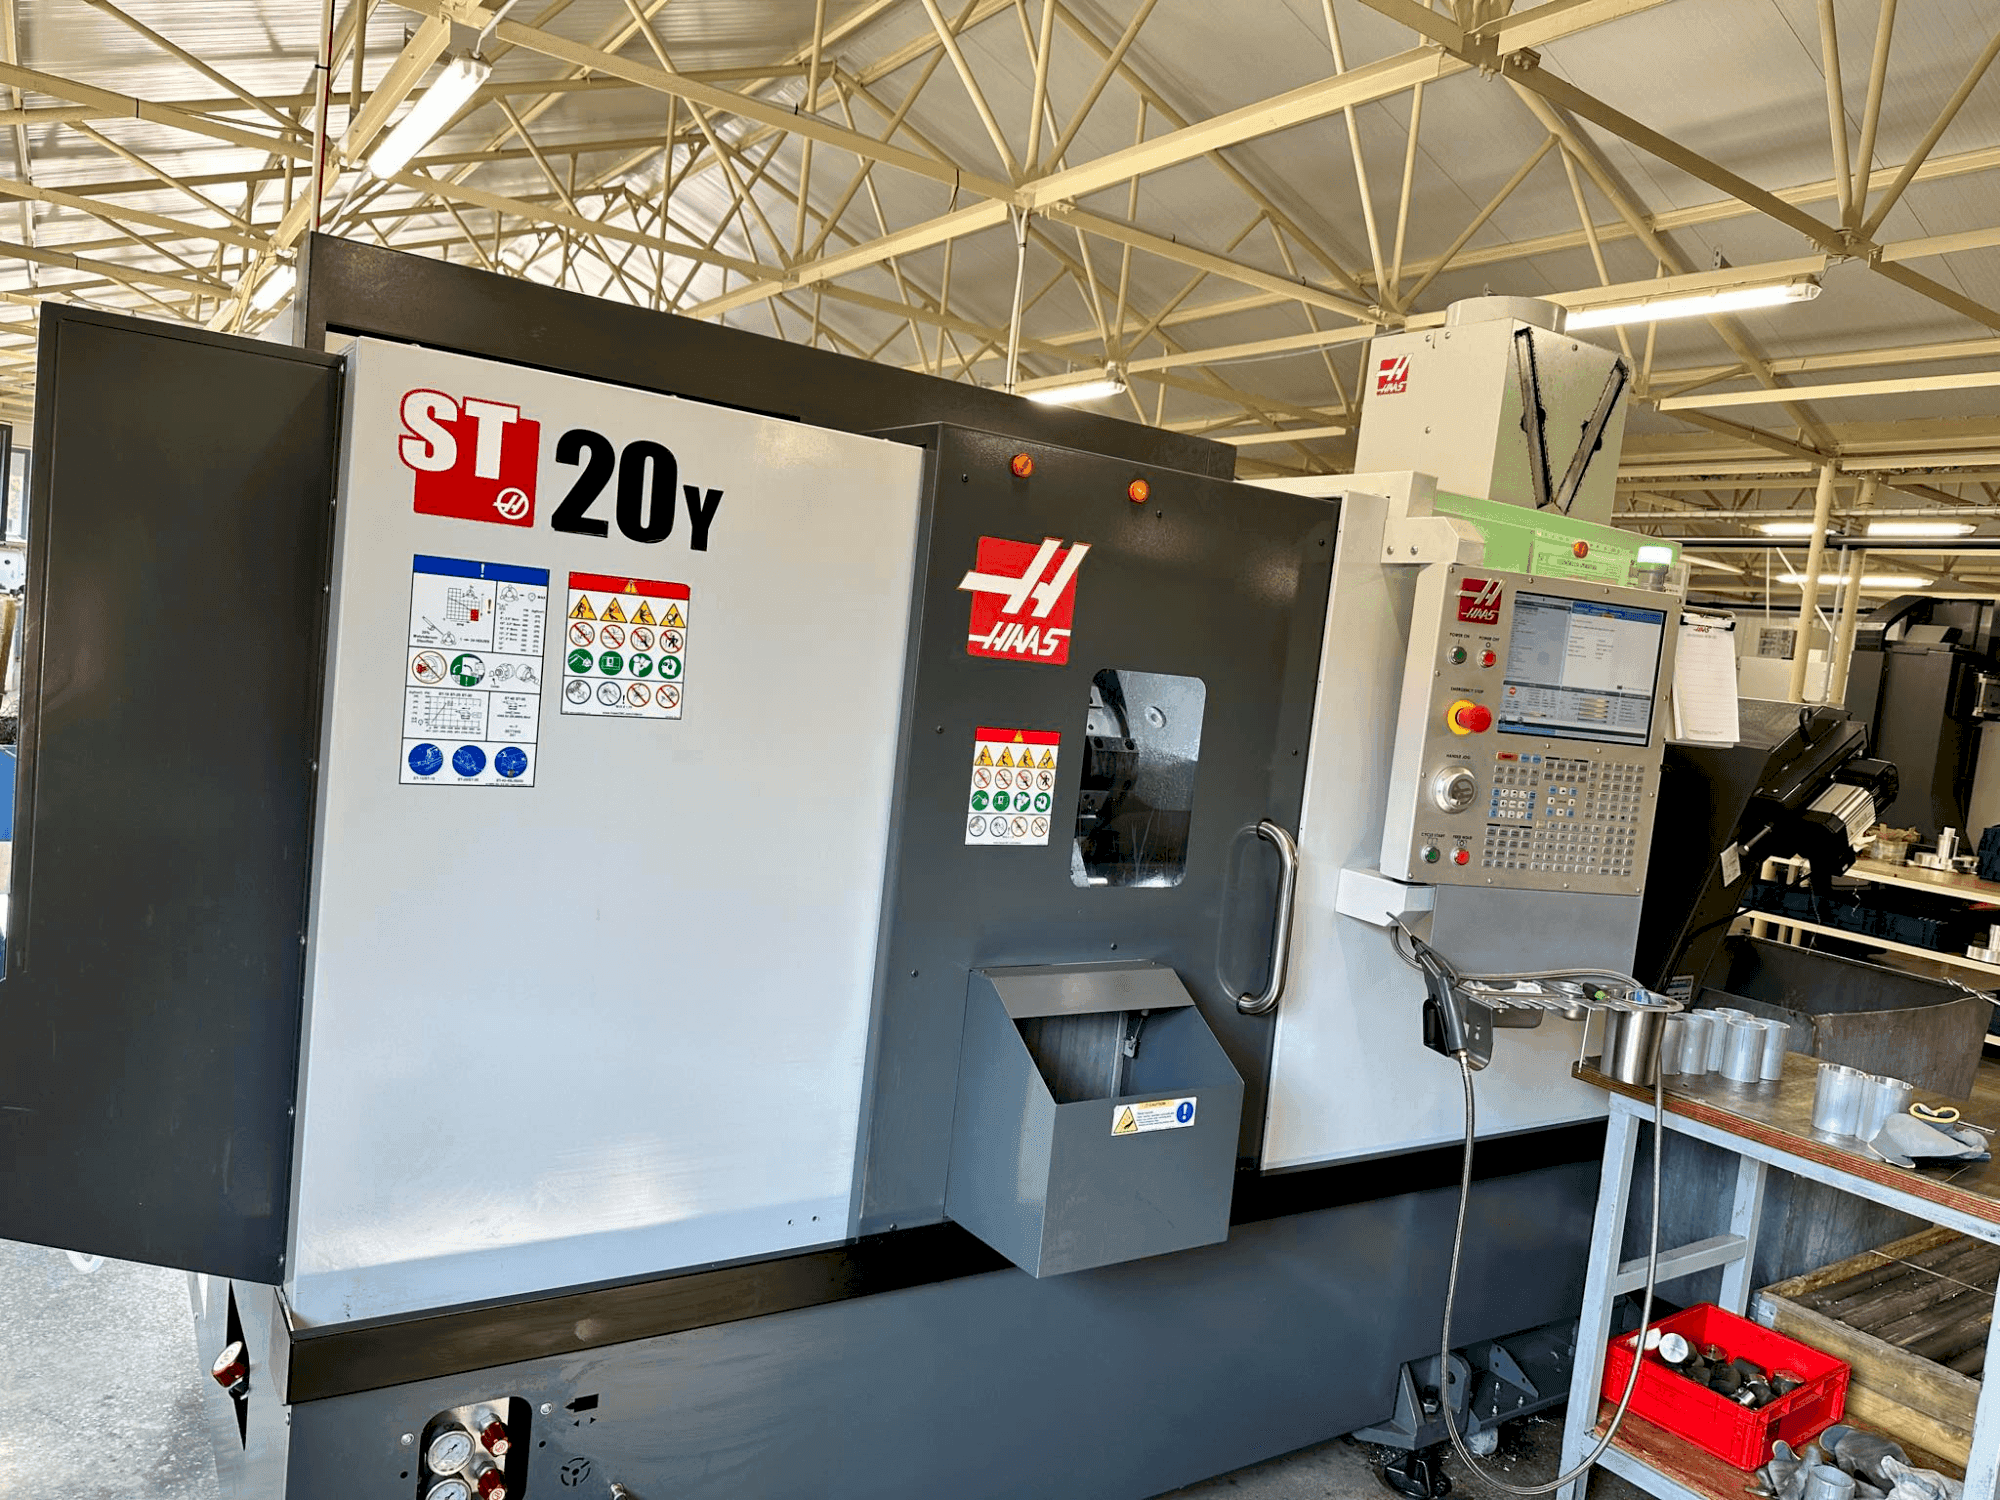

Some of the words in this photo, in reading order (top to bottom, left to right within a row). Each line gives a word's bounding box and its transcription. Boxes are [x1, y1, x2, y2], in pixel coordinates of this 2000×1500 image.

[398, 388, 520, 481] ST
[551, 428, 724, 552] 20Y
[1460, 607, 1499, 620] HAAS
[968, 621, 1072, 656] HAAS
